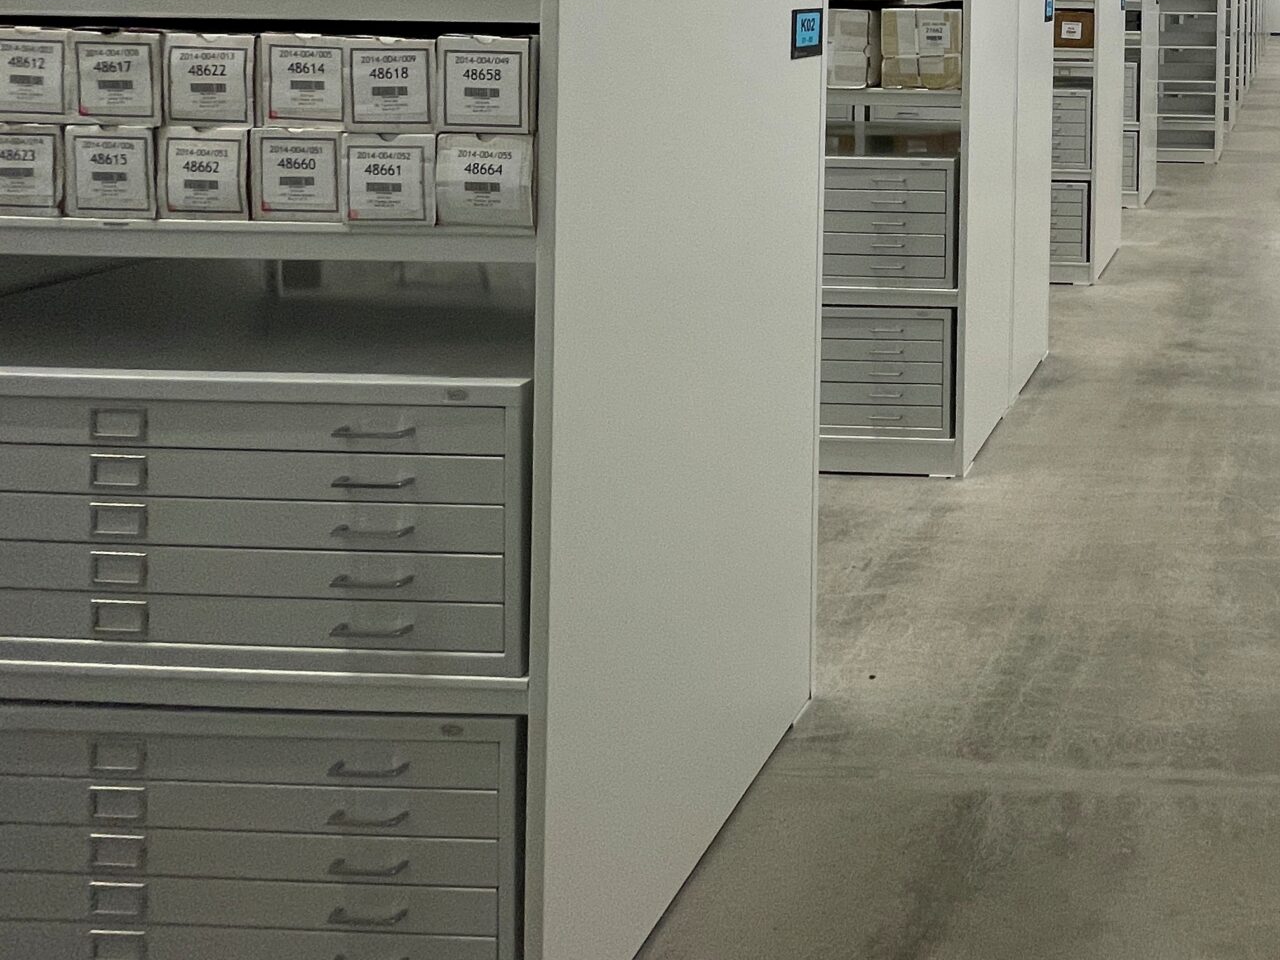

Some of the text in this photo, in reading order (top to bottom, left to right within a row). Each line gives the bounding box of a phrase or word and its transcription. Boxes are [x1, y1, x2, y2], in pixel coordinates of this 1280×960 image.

[800, 17, 816, 32] K02
[7, 57, 45, 69] 48612
[361, 55, 416, 64] 2014-004/009
[455, 56, 510, 65] 2014-004/049
[92, 60, 132, 73] 48617
[187, 64, 227, 77] 48622
[287, 62, 325, 74] 48614
[369, 67, 409, 79] 48618
[463, 69, 501, 81] 48658
[90, 153, 128, 166] 48615
[357, 151, 411, 160] 2014-004/052
[457, 150, 512, 159] 2014-004/055
[182, 161, 220, 173] 48662
[277, 158, 316, 170] 48660
[364, 163, 402, 176] 48661
[464, 163, 503, 176] 48664
